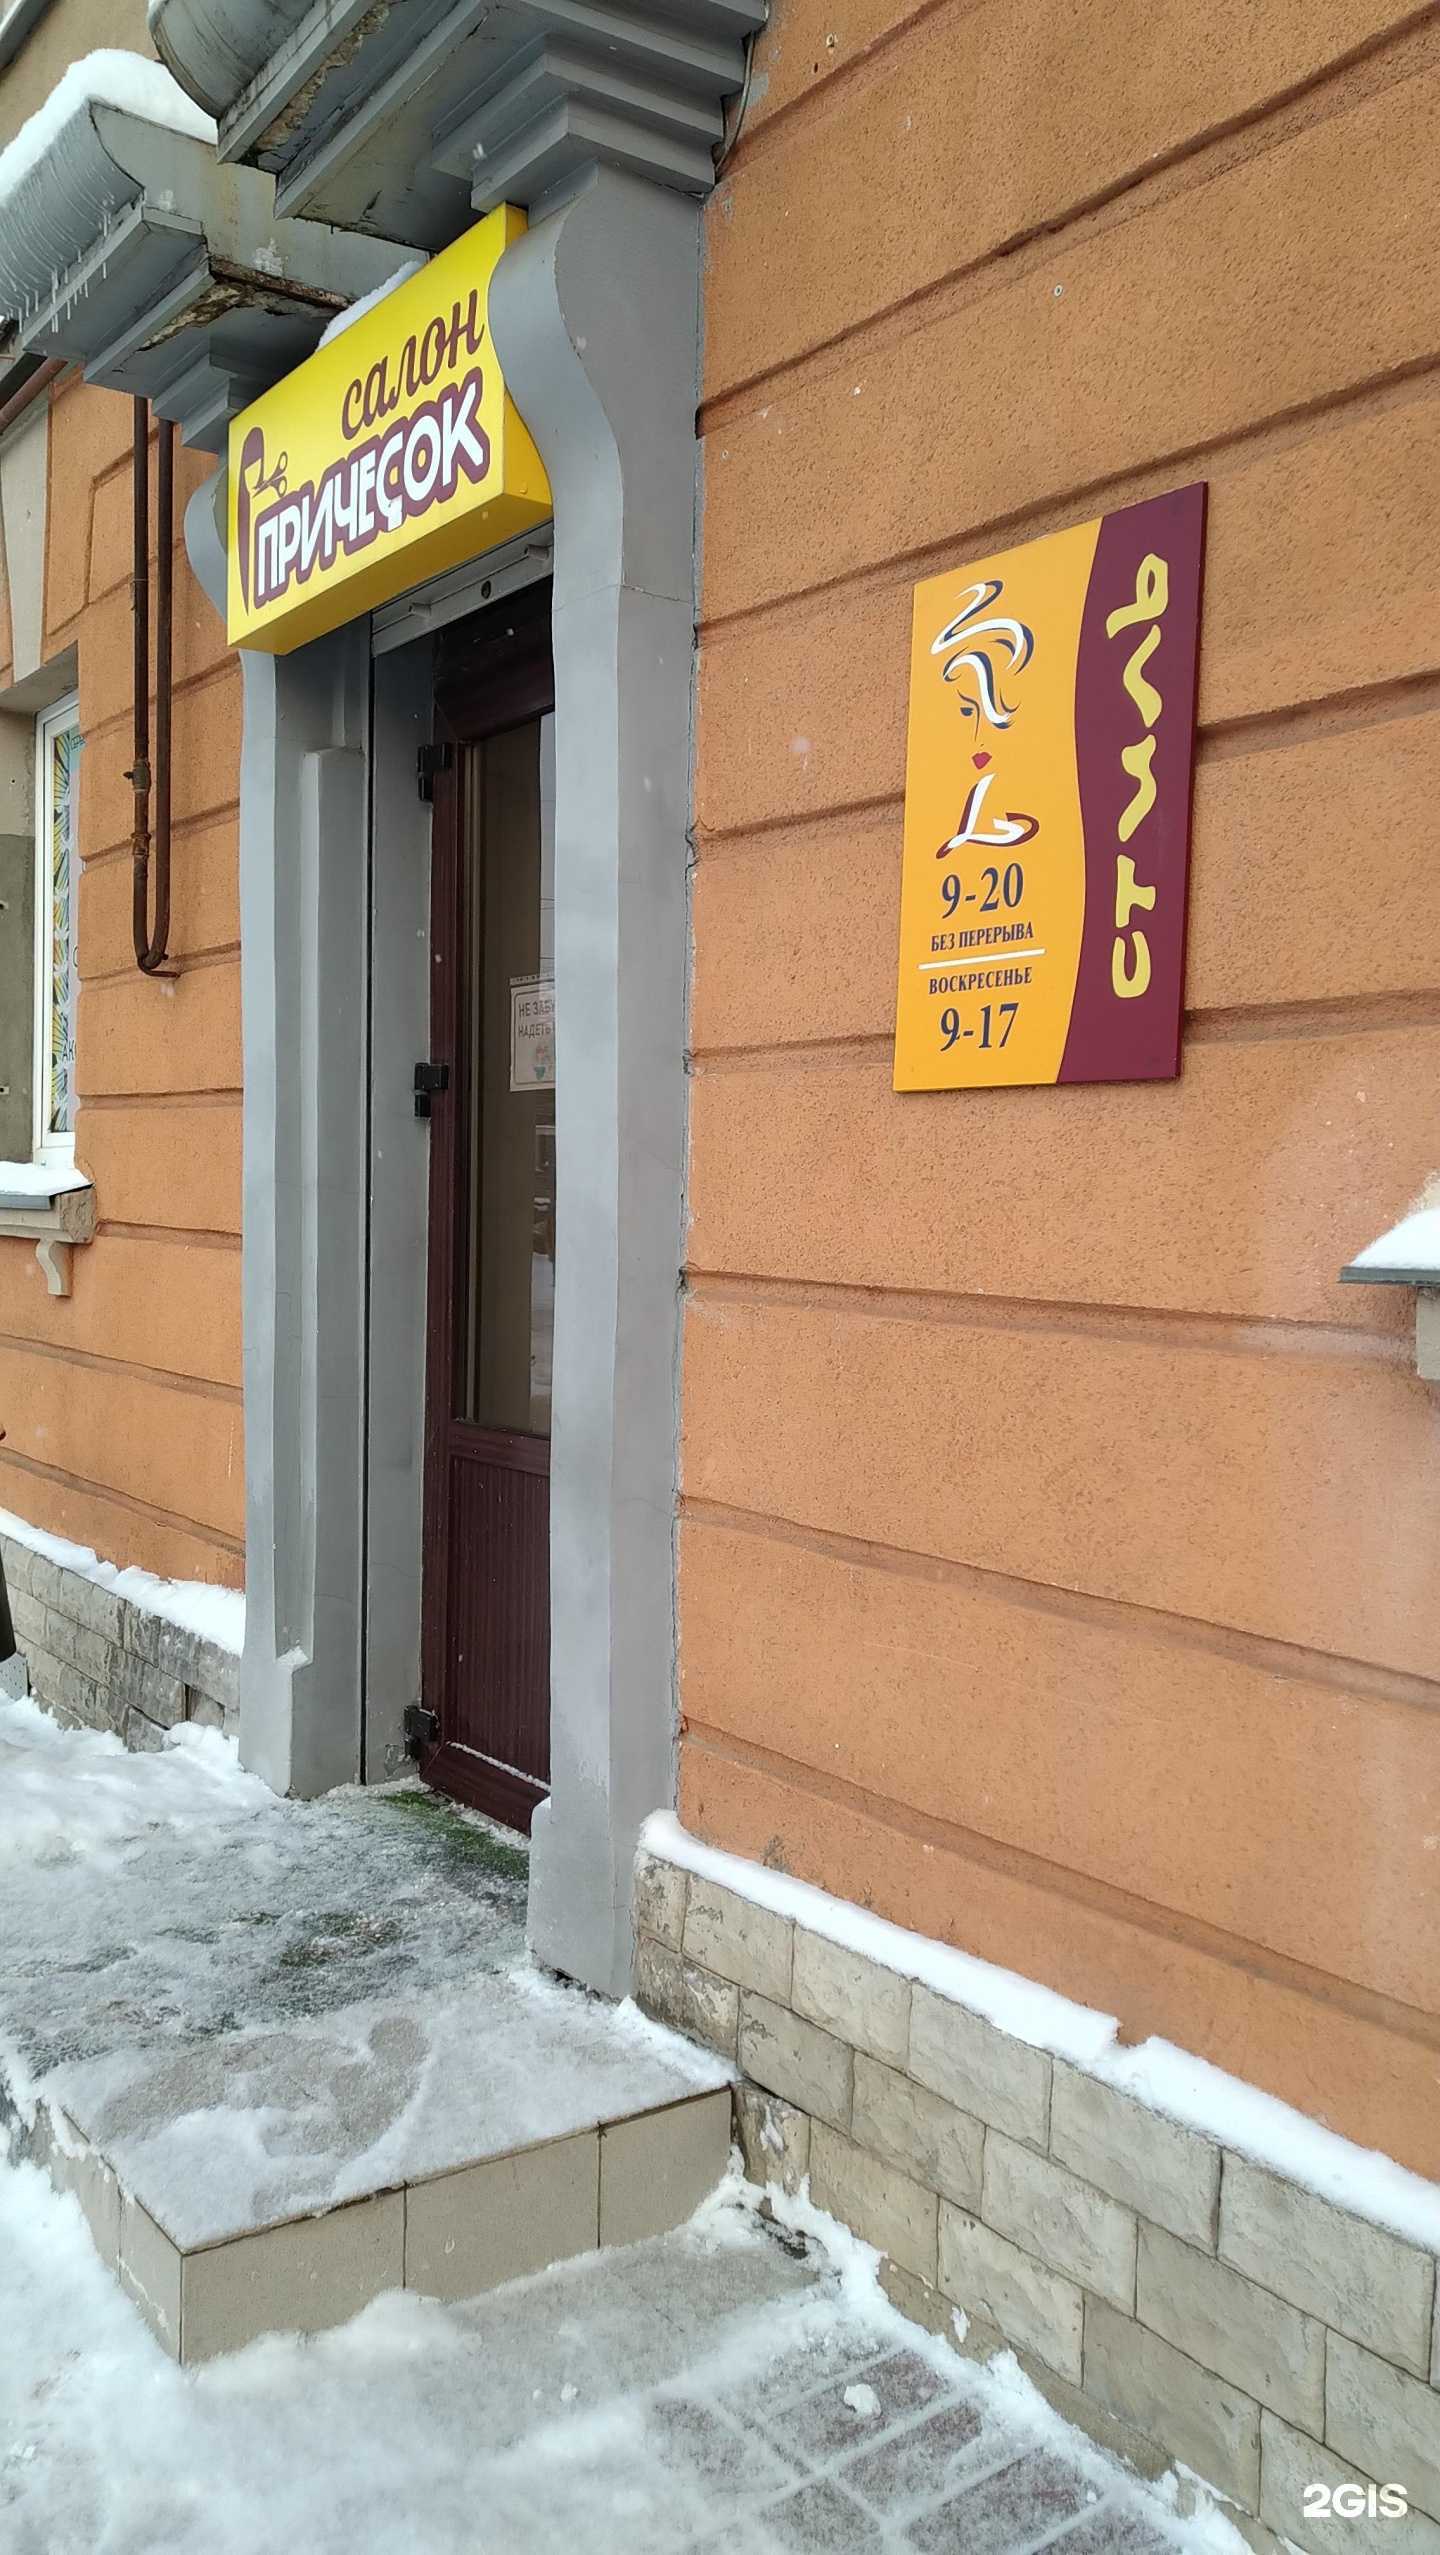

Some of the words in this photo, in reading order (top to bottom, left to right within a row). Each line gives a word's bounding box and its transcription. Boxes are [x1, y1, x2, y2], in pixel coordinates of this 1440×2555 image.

[342, 289, 485, 441] салон
[256, 373, 488, 604] ПРИЧЕСОК
[941, 862, 1025, 919] 9-20
[931, 934, 956, 952] БЕЗ
[958, 921, 1034, 949] ПЕРЕРЫВА
[928, 966, 1033, 995] ВОСКРЕСЕНЬЕ
[518, 1002, 531, 1017] НЕ
[940, 1002, 1020, 1051] 9-17
